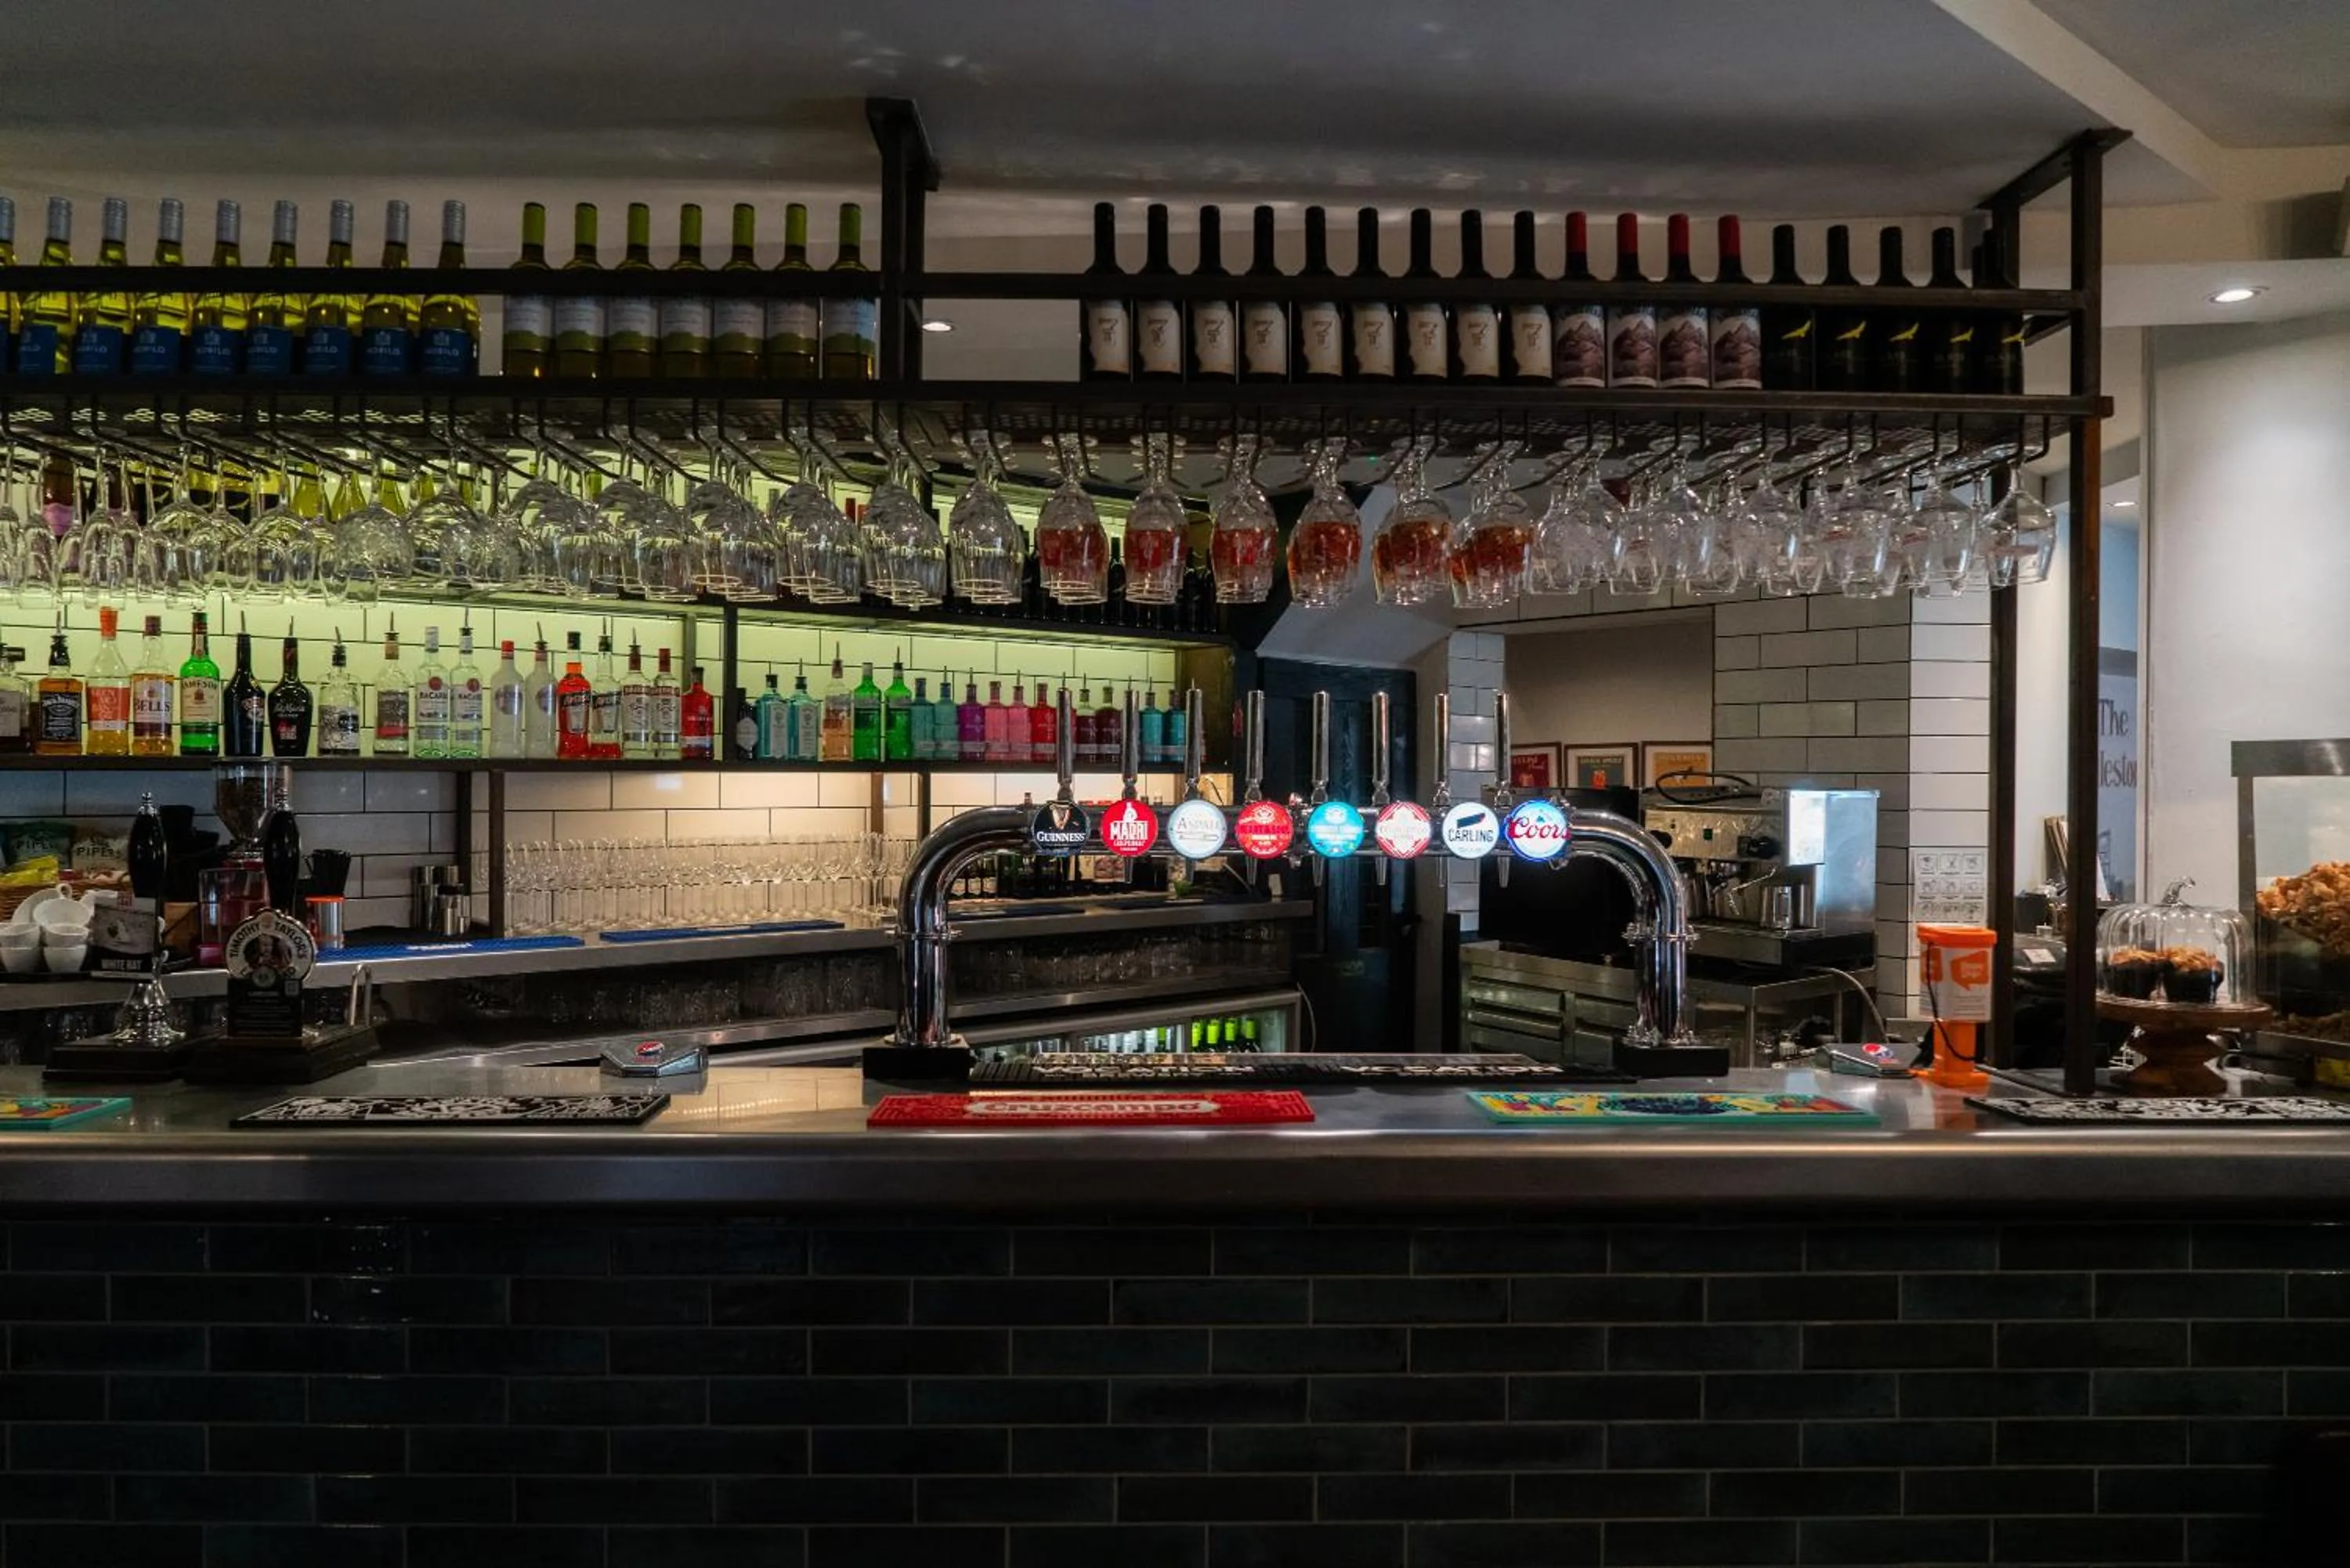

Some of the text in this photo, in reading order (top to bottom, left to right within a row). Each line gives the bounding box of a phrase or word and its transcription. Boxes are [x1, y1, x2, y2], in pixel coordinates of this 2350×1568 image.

[2099, 698, 2128, 736] The
[1036, 831, 1086, 842] GUINNESS
[1448, 829, 1494, 842] CARLING
[1507, 816, 1571, 840] Coors
[230, 922, 260, 958] TIMOTHY
[985, 1102, 1201, 1113] Cruzcampo
